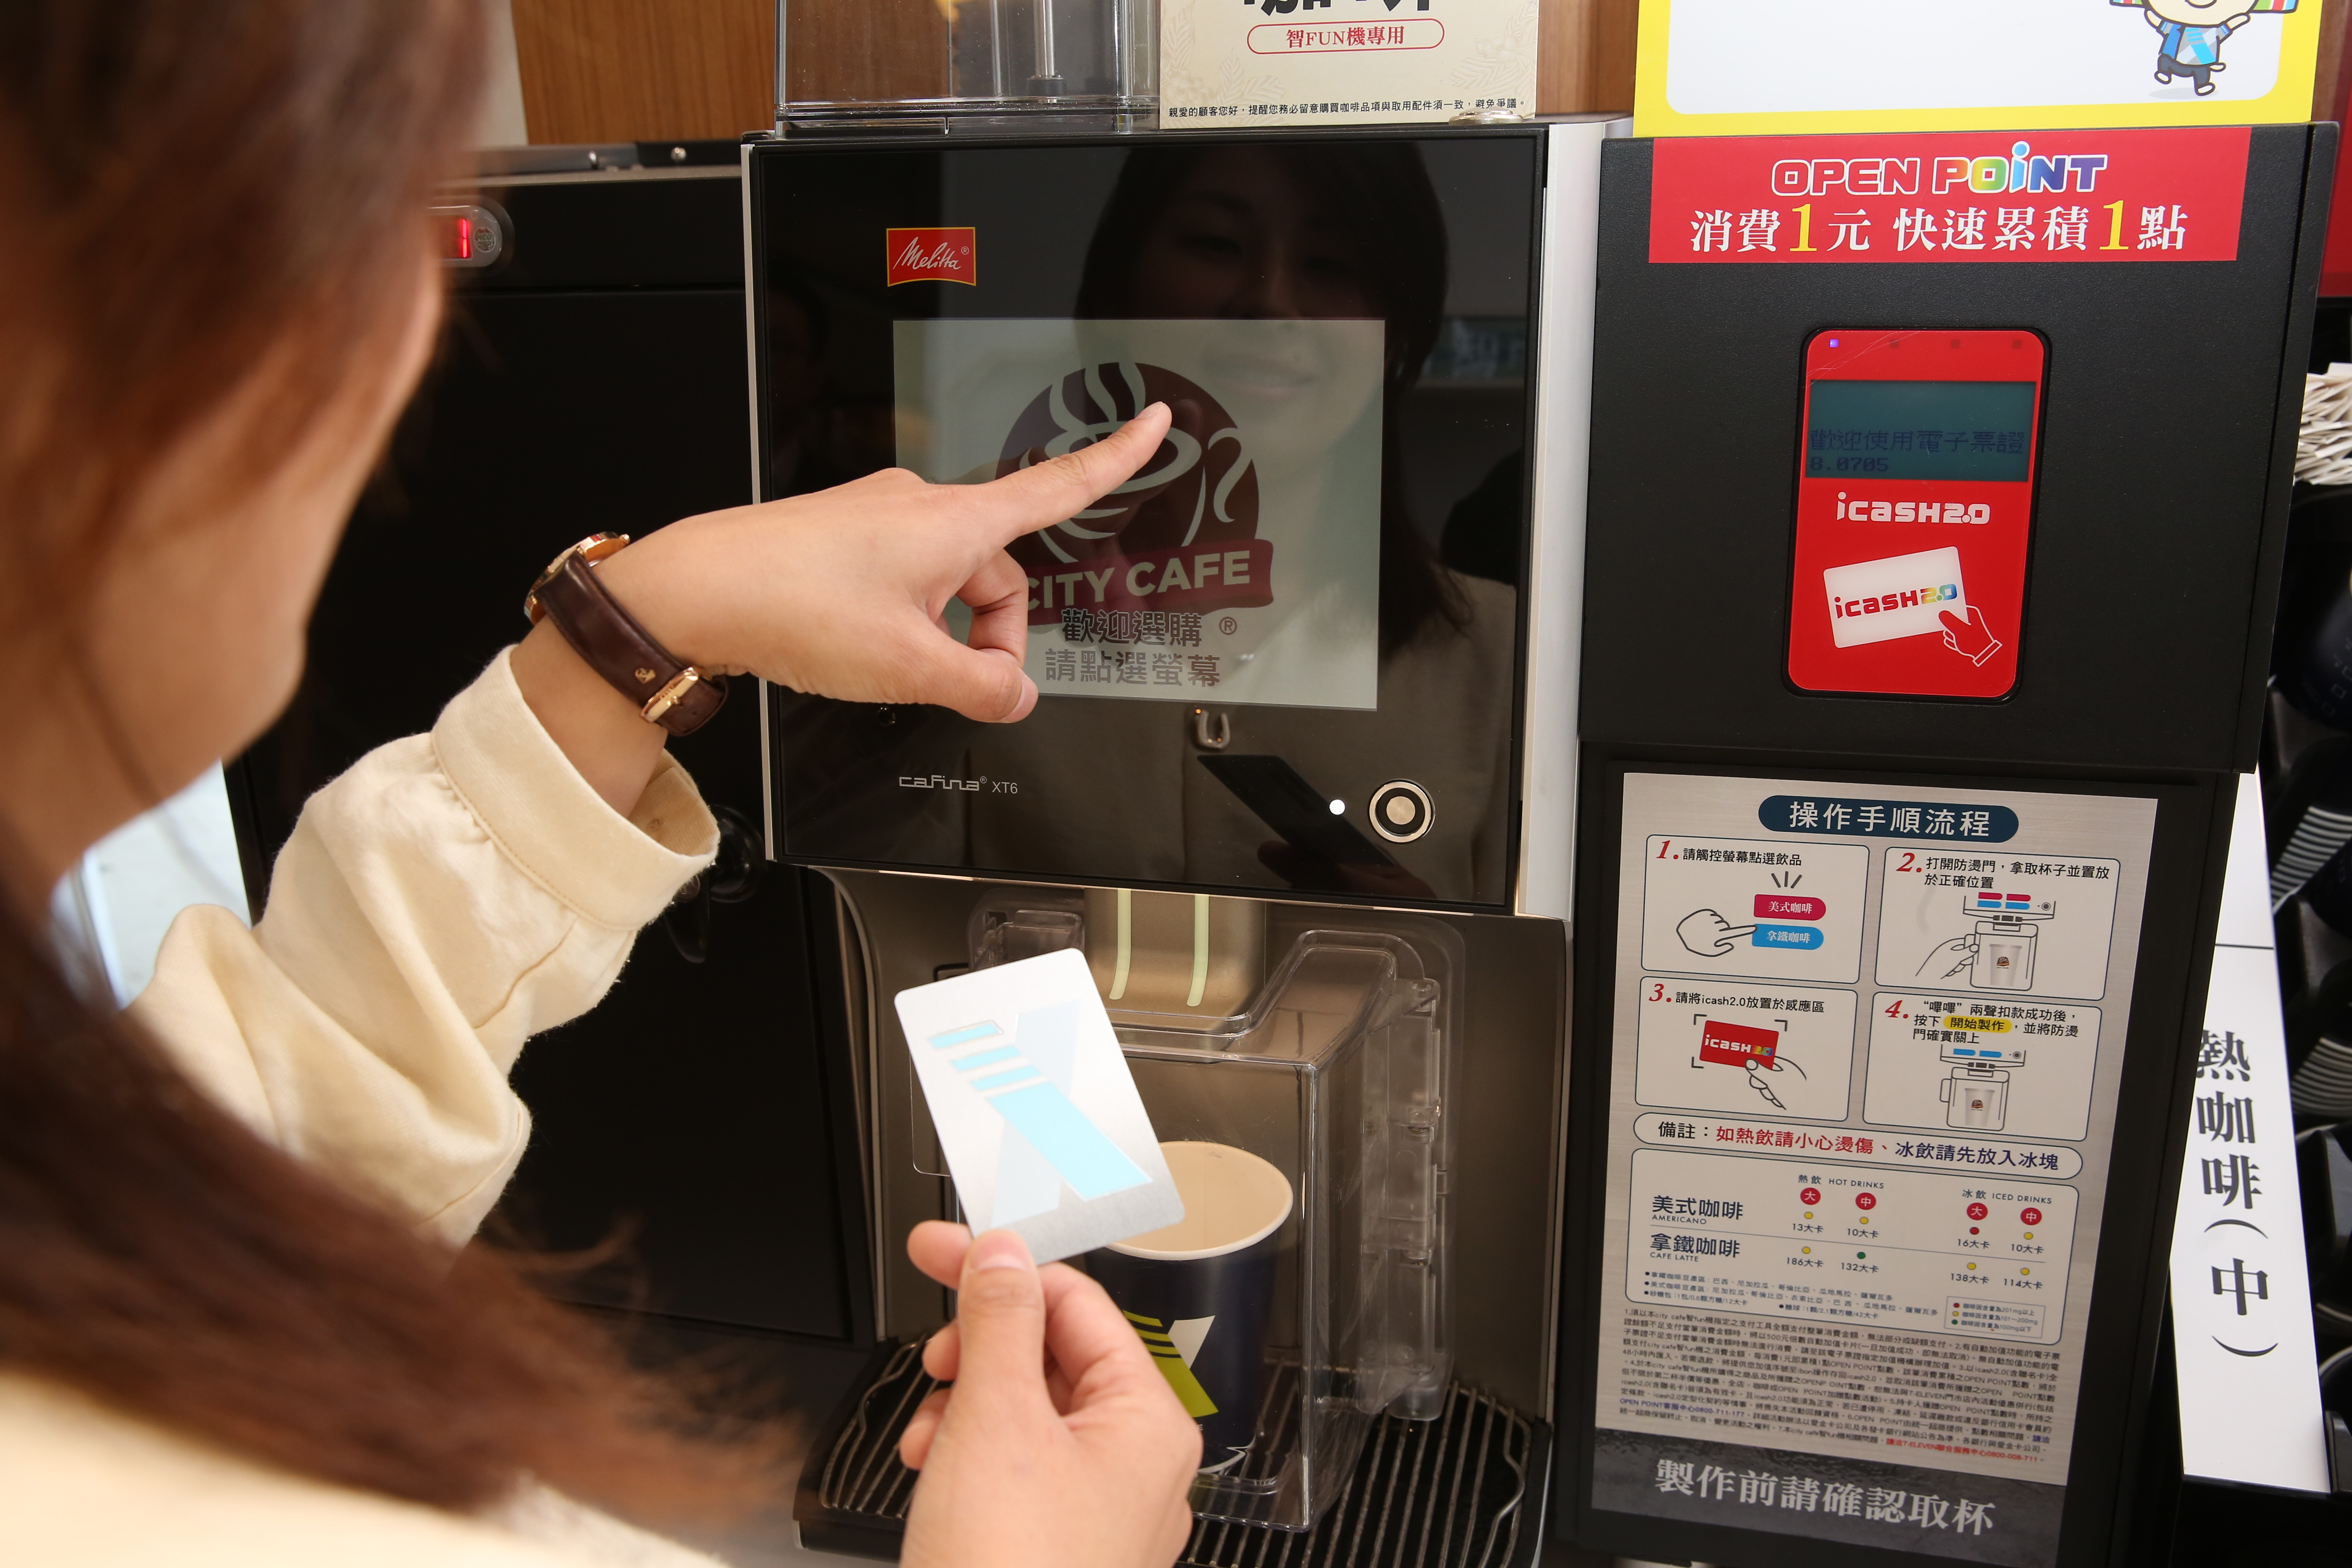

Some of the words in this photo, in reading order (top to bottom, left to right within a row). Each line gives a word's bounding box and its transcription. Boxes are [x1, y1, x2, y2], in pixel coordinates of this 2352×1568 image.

[1286, 25, 1405, 49] 智FUN機專用
[1771, 158, 1921, 196] OPEN
[1690, 202, 1871, 252] 消費1元
[1892, 200, 2189, 251] 快速累積1點
[1810, 428, 2025, 454] 歡迎使用電子票證
[1125, 550, 1251, 597] CAFE
[1060, 608, 1203, 648] 歡迎選購
[1044, 648, 1221, 688] 請點選螢幕
[992, 781, 1018, 794] XT6
[1789, 801, 1991, 838] 操作手順流程
[1682, 848, 1802, 866] 請觸控螢幕點選飲品
[1925, 857, 2110, 880] 打開防燙門，拿取杯子並置放
[1924, 873, 1994, 889] 於正確位置
[1768, 901, 1813, 914] 美式咖啡
[1766, 930, 1811, 944] 拿鐵咖啡
[1675, 991, 1825, 1013] 請將icash2.0放置於感應區
[1913, 1014, 1942, 1027] 按下
[1950, 1017, 2005, 1031] 開始製作
[1912, 1028, 1980, 1044] 門確實關上
[1828, 1178, 1848, 1186] HOT
[1851, 1180, 1884, 1189] DRINKS
[1652, 1194, 1744, 1220] 美式咖啡
[1804, 1191, 1816, 1201] 大
[1860, 1196, 1872, 1207] 中
[1971, 1206, 1983, 1216] 大
[2025, 1212, 2037, 1222] 中
[1992, 1193, 2013, 1201] ICED
[2017, 1195, 2052, 1205] DRINKS
[1652, 1214, 1707, 1225] AMERICANO
[1650, 1233, 1740, 1258] 拿鐵咖啡
[1792, 1223, 1824, 1234] 13大卡
[1846, 1228, 1879, 1239] 10大卡
[1956, 1238, 1990, 1249] 16大卡
[2010, 1243, 2045, 1254] 10大卡
[1786, 1257, 1824, 1268] 186大卡
[1841, 1262, 1879, 1274] 132大卡
[1950, 1273, 1990, 1284] 138大卡
[2003, 1278, 2043, 1290] 114大卡
[1654, 1459, 1996, 1536] 製作前請確認取杯
